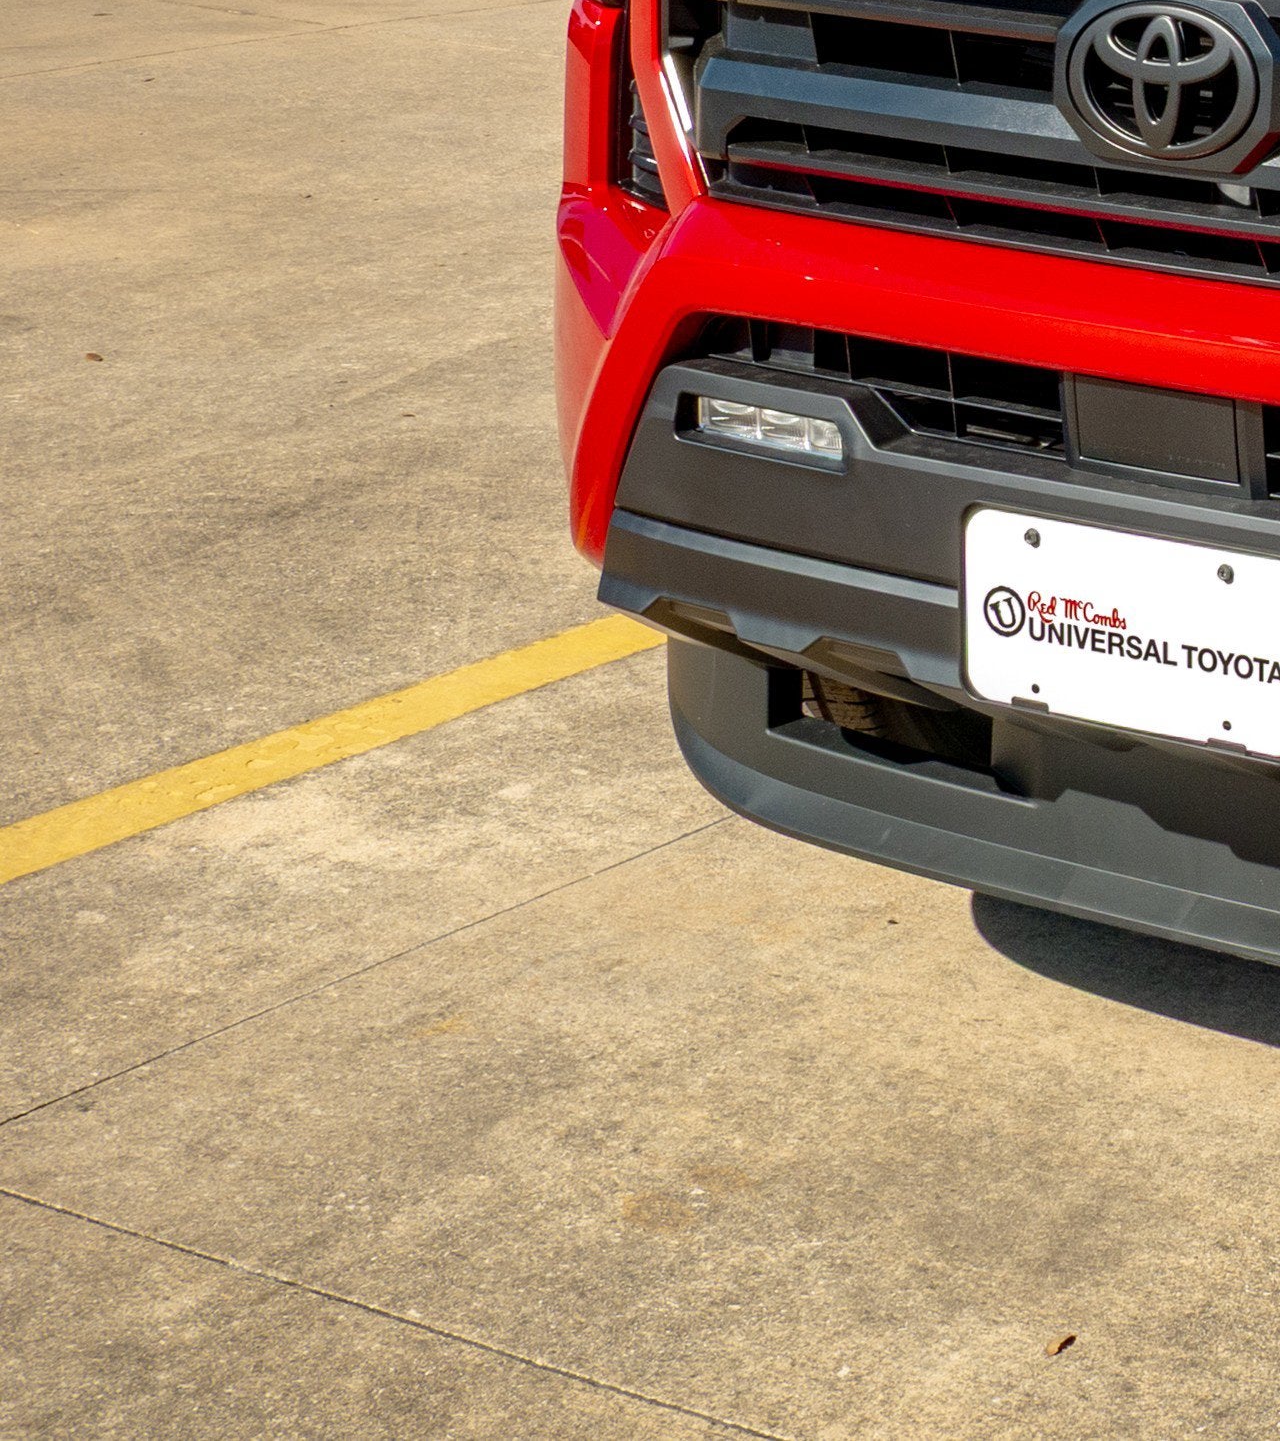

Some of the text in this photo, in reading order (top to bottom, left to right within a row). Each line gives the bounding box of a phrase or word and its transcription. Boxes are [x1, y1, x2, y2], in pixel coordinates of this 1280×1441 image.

[1027, 591, 1128, 630] Red McCombs
[1028, 616, 1178, 667] UNIVERSAL
